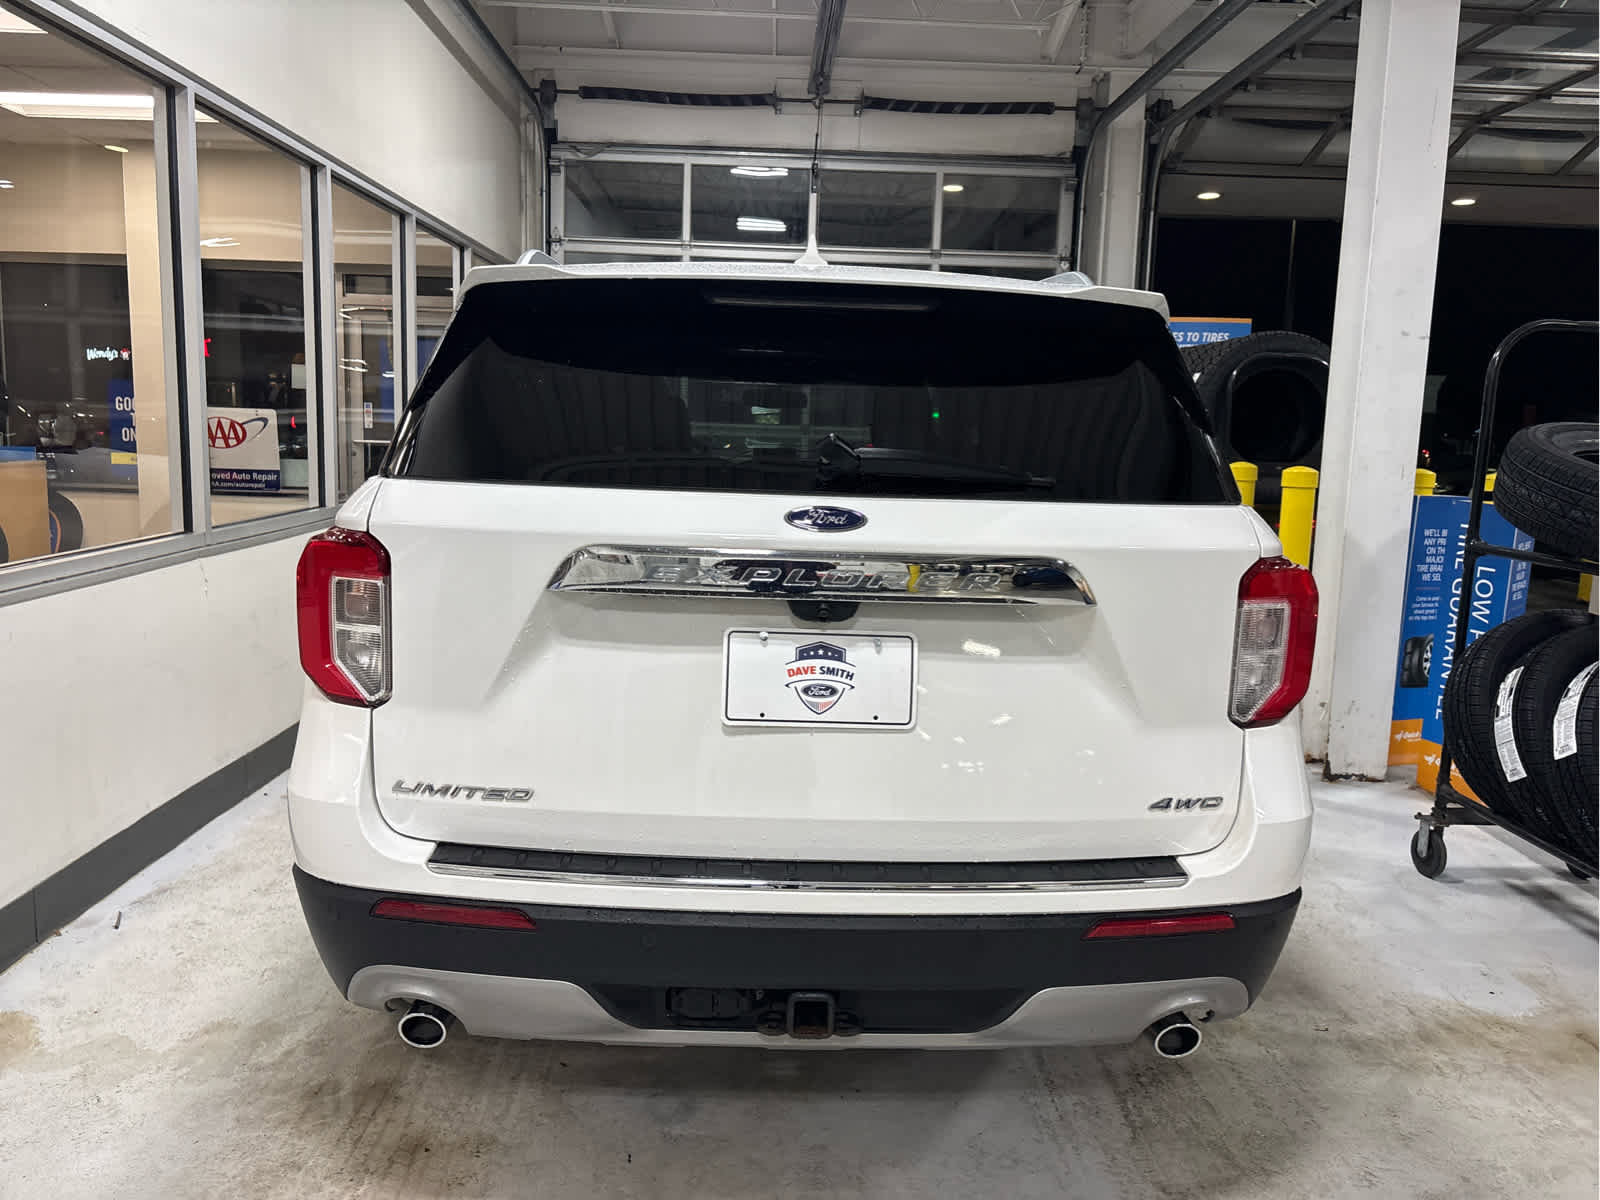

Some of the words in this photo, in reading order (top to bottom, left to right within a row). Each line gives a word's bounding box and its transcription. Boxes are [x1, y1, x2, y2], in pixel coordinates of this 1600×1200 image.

[1187, 332, 1200, 342] TO
[1202, 332, 1230, 342] TIRES
[232, 472, 251, 480] Auto
[252, 473, 278, 482] Repair
[804, 506, 849, 525] Ford
[648, 564, 1003, 592] EXPLORER
[1472, 566, 1496, 624] LOW
[787, 665, 817, 678] DAVE
[819, 665, 855, 681] SMITH
[807, 685, 832, 697] Ford
[392, 779, 535, 801] LIMITED
[1148, 796, 1223, 810] 4WD
